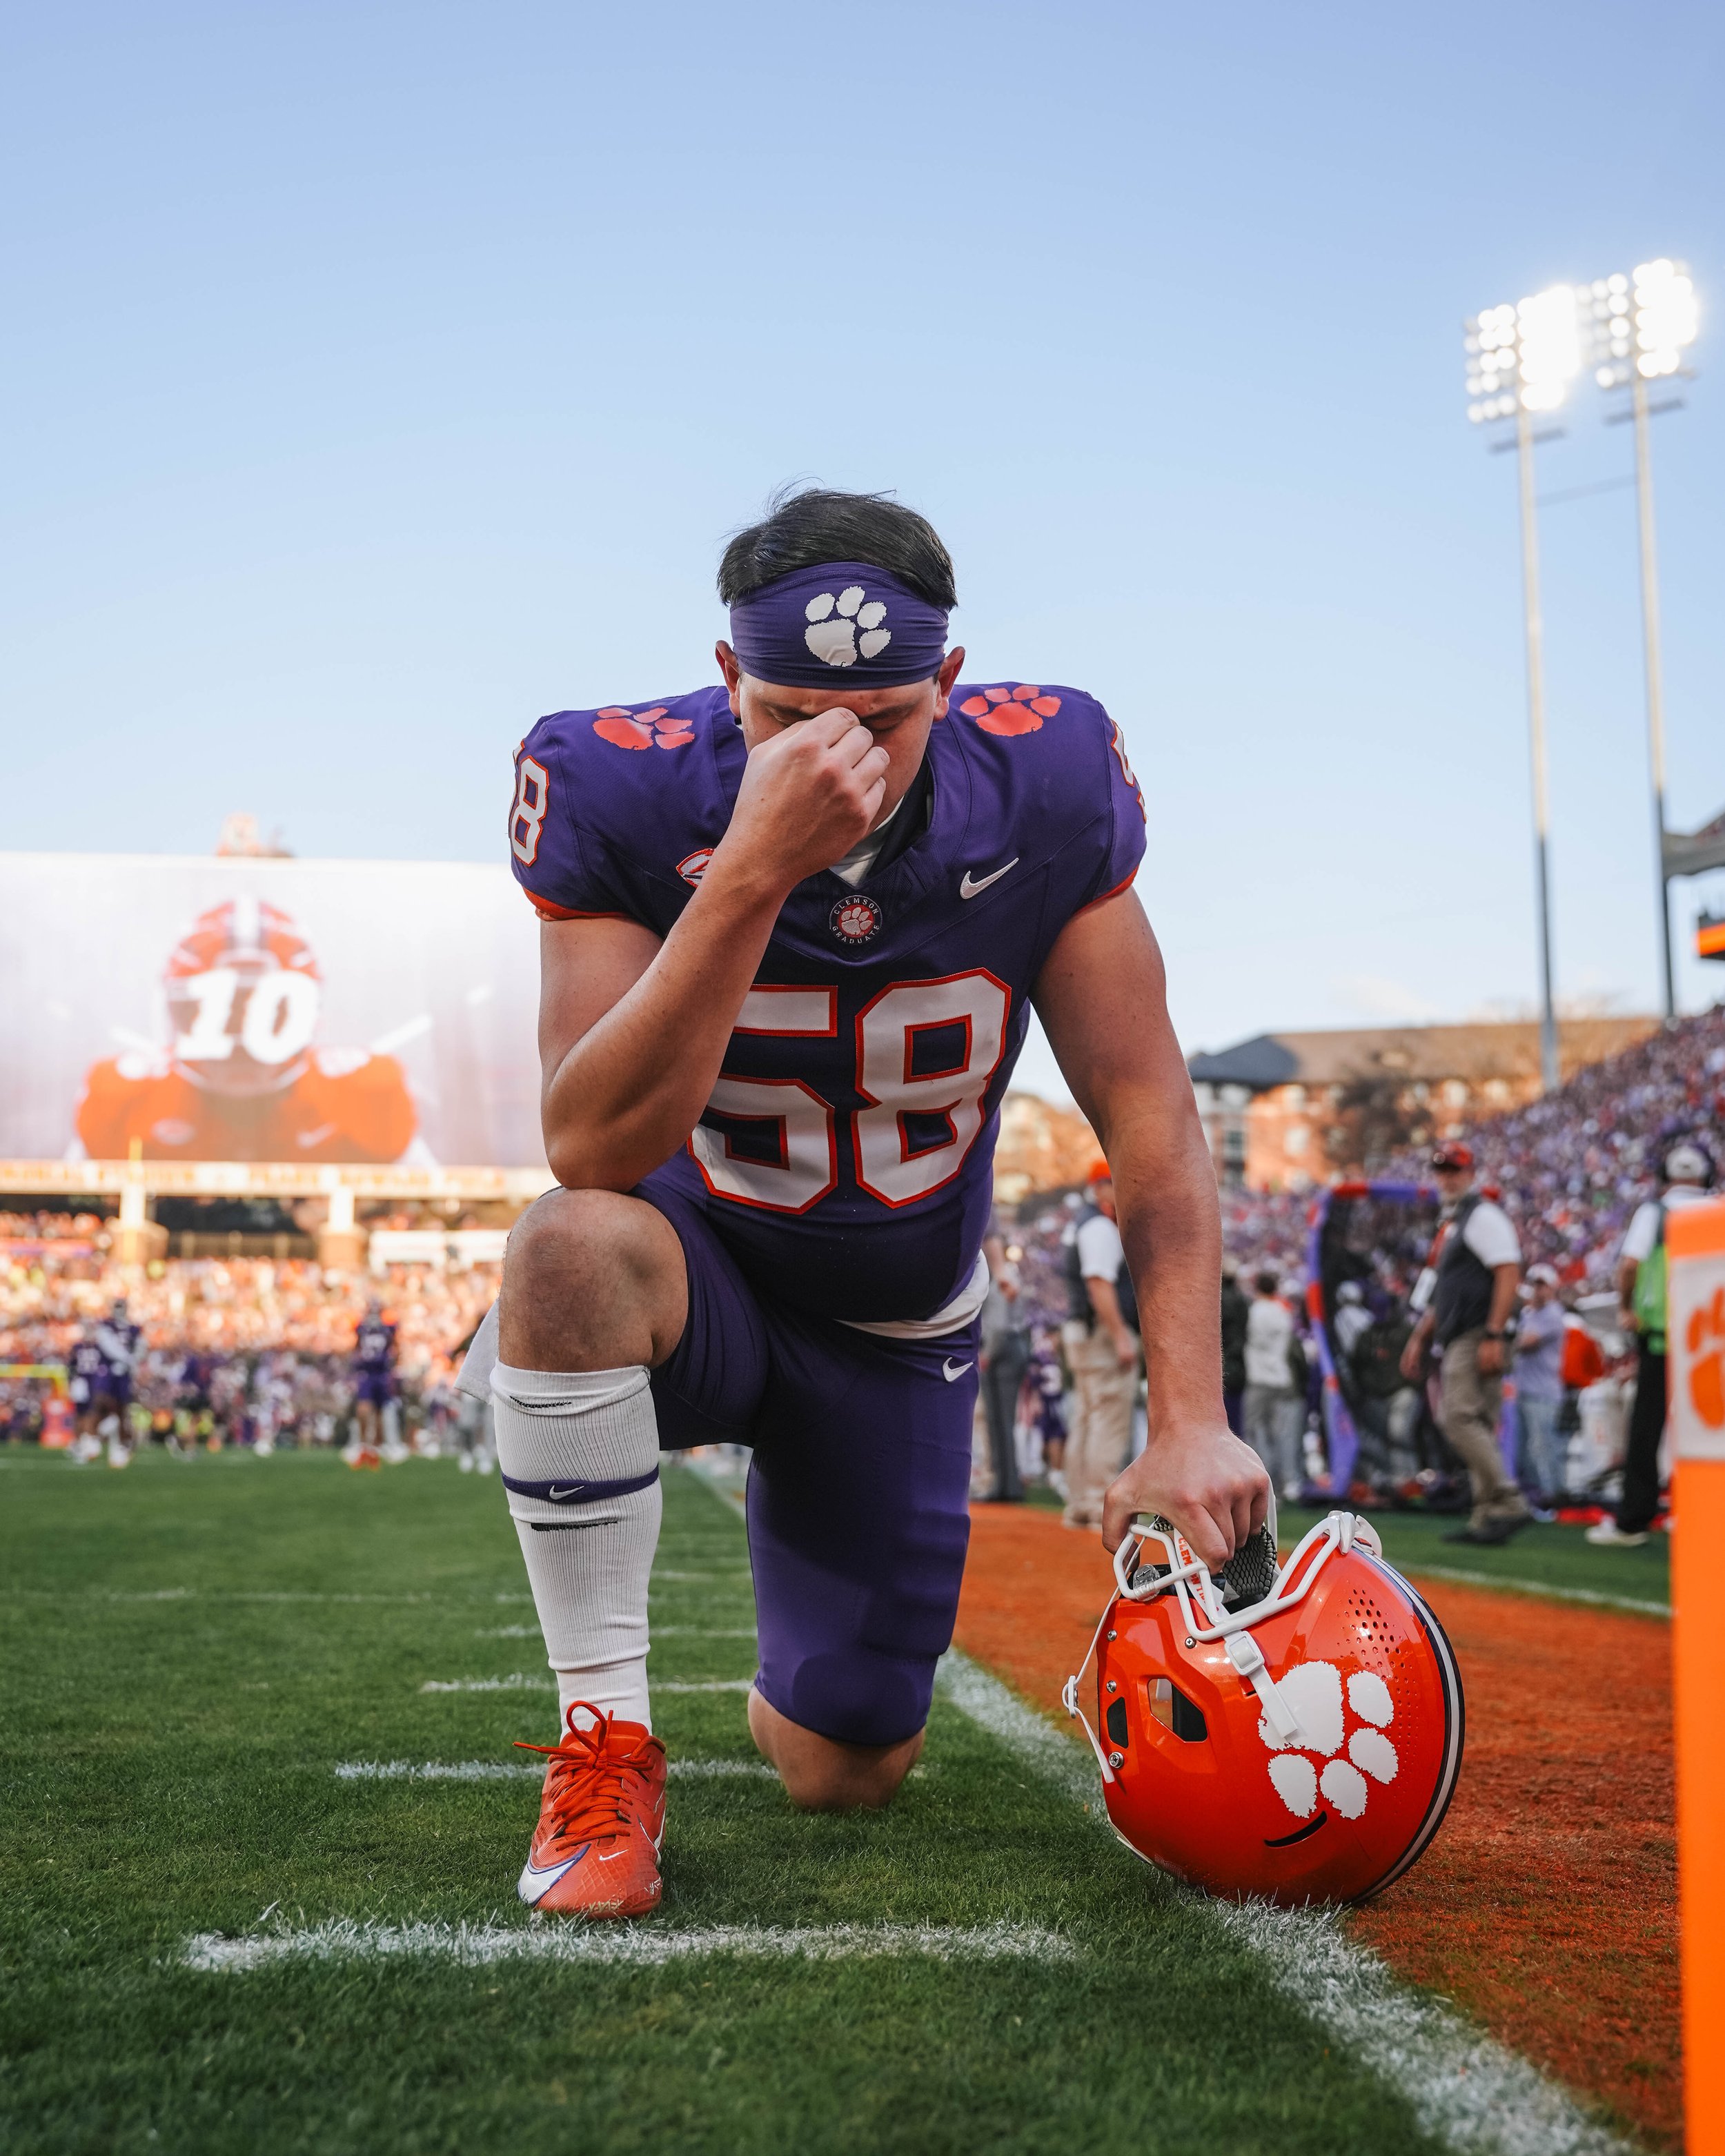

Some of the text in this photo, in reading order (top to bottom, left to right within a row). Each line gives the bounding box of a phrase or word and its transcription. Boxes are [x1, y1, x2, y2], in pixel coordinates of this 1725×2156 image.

[509, 740, 550, 867] 8
[832, 925, 880, 944] GRADUATE
[834, 898, 879, 915] CLEMSON
[176, 968, 321, 1064] 10
[687, 967, 1012, 1216] 58
